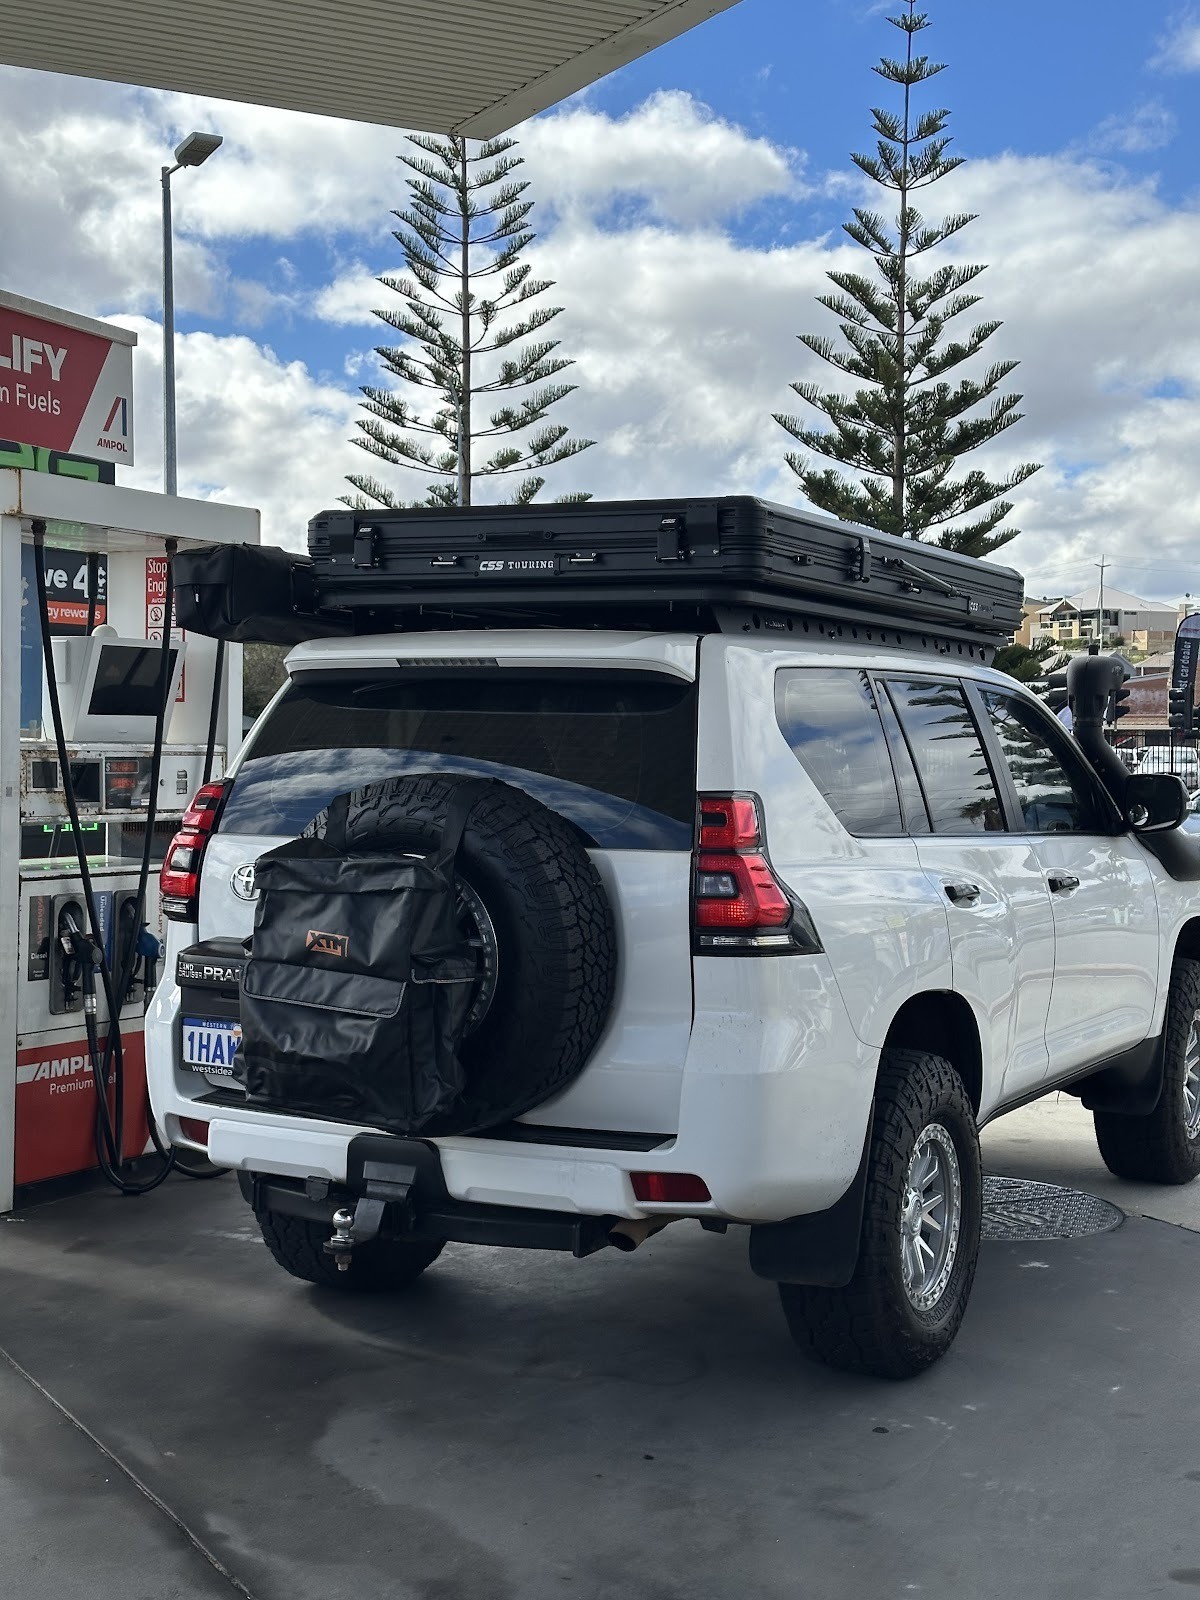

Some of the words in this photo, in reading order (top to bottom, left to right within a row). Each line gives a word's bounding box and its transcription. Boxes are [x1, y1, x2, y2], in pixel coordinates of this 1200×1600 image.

[16, 382, 61, 416] Fuels
[97, 437, 128, 453] AMPOL
[148, 558, 168, 578] Stop
[479, 560, 505, 571] CSS
[507, 560, 554, 569] TOURING
[147, 577, 168, 597] Engi
[60, 607, 101, 620] rewars
[1180, 641, 1192, 664] dealer
[1180, 665, 1189, 678] car
[178, 962, 194, 971] LAND
[178, 969, 203, 980] CRUISER
[202, 1021, 227, 1029] WESTERN
[50, 1078, 94, 1095] Premium
